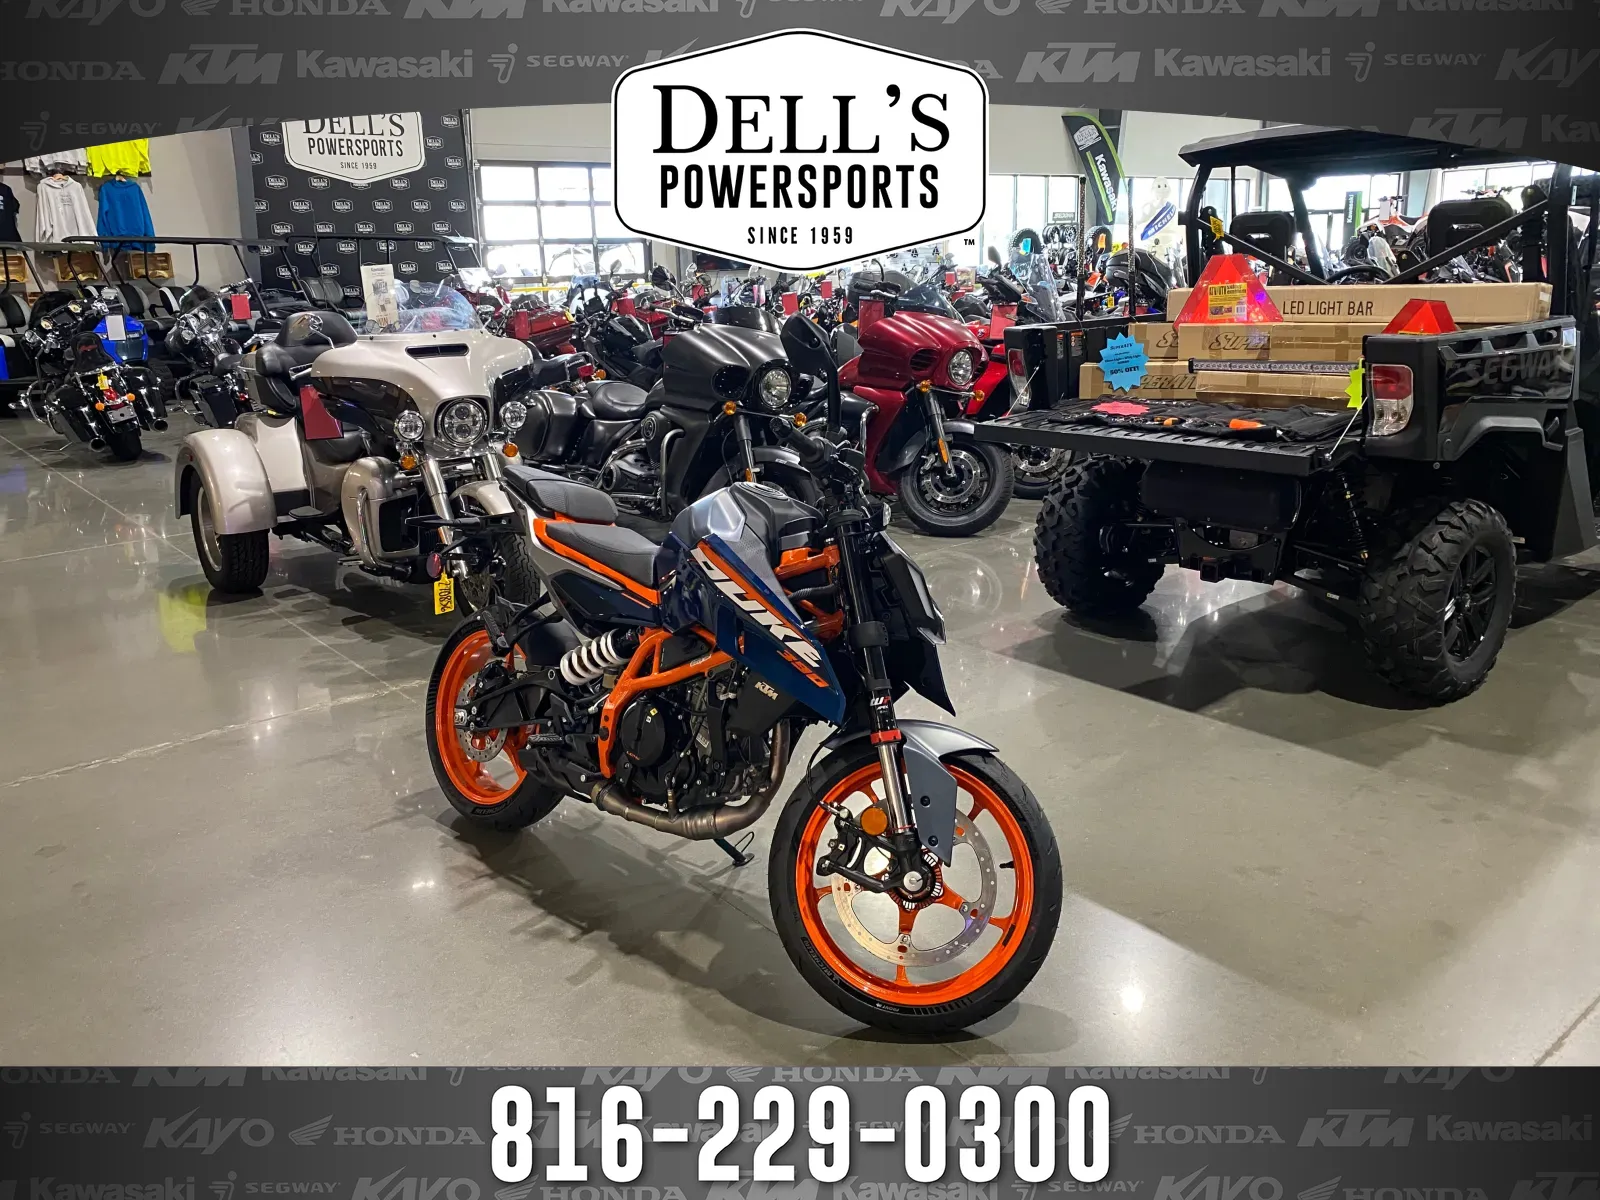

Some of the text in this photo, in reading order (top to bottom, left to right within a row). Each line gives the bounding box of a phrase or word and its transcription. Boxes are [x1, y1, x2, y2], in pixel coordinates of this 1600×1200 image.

[302, 113, 405, 137] DELL'S
[309, 138, 403, 157] POWERSPORTS
[340, 162, 377, 170] SINCE 1959
[1094, 153, 1119, 213] Kawasaki
[1282, 300, 1374, 316] LED LIGHT BAR
[690, 546, 822, 668] DUKE
[776, 649, 829, 689] 390
[754, 681, 779, 701] KTM
